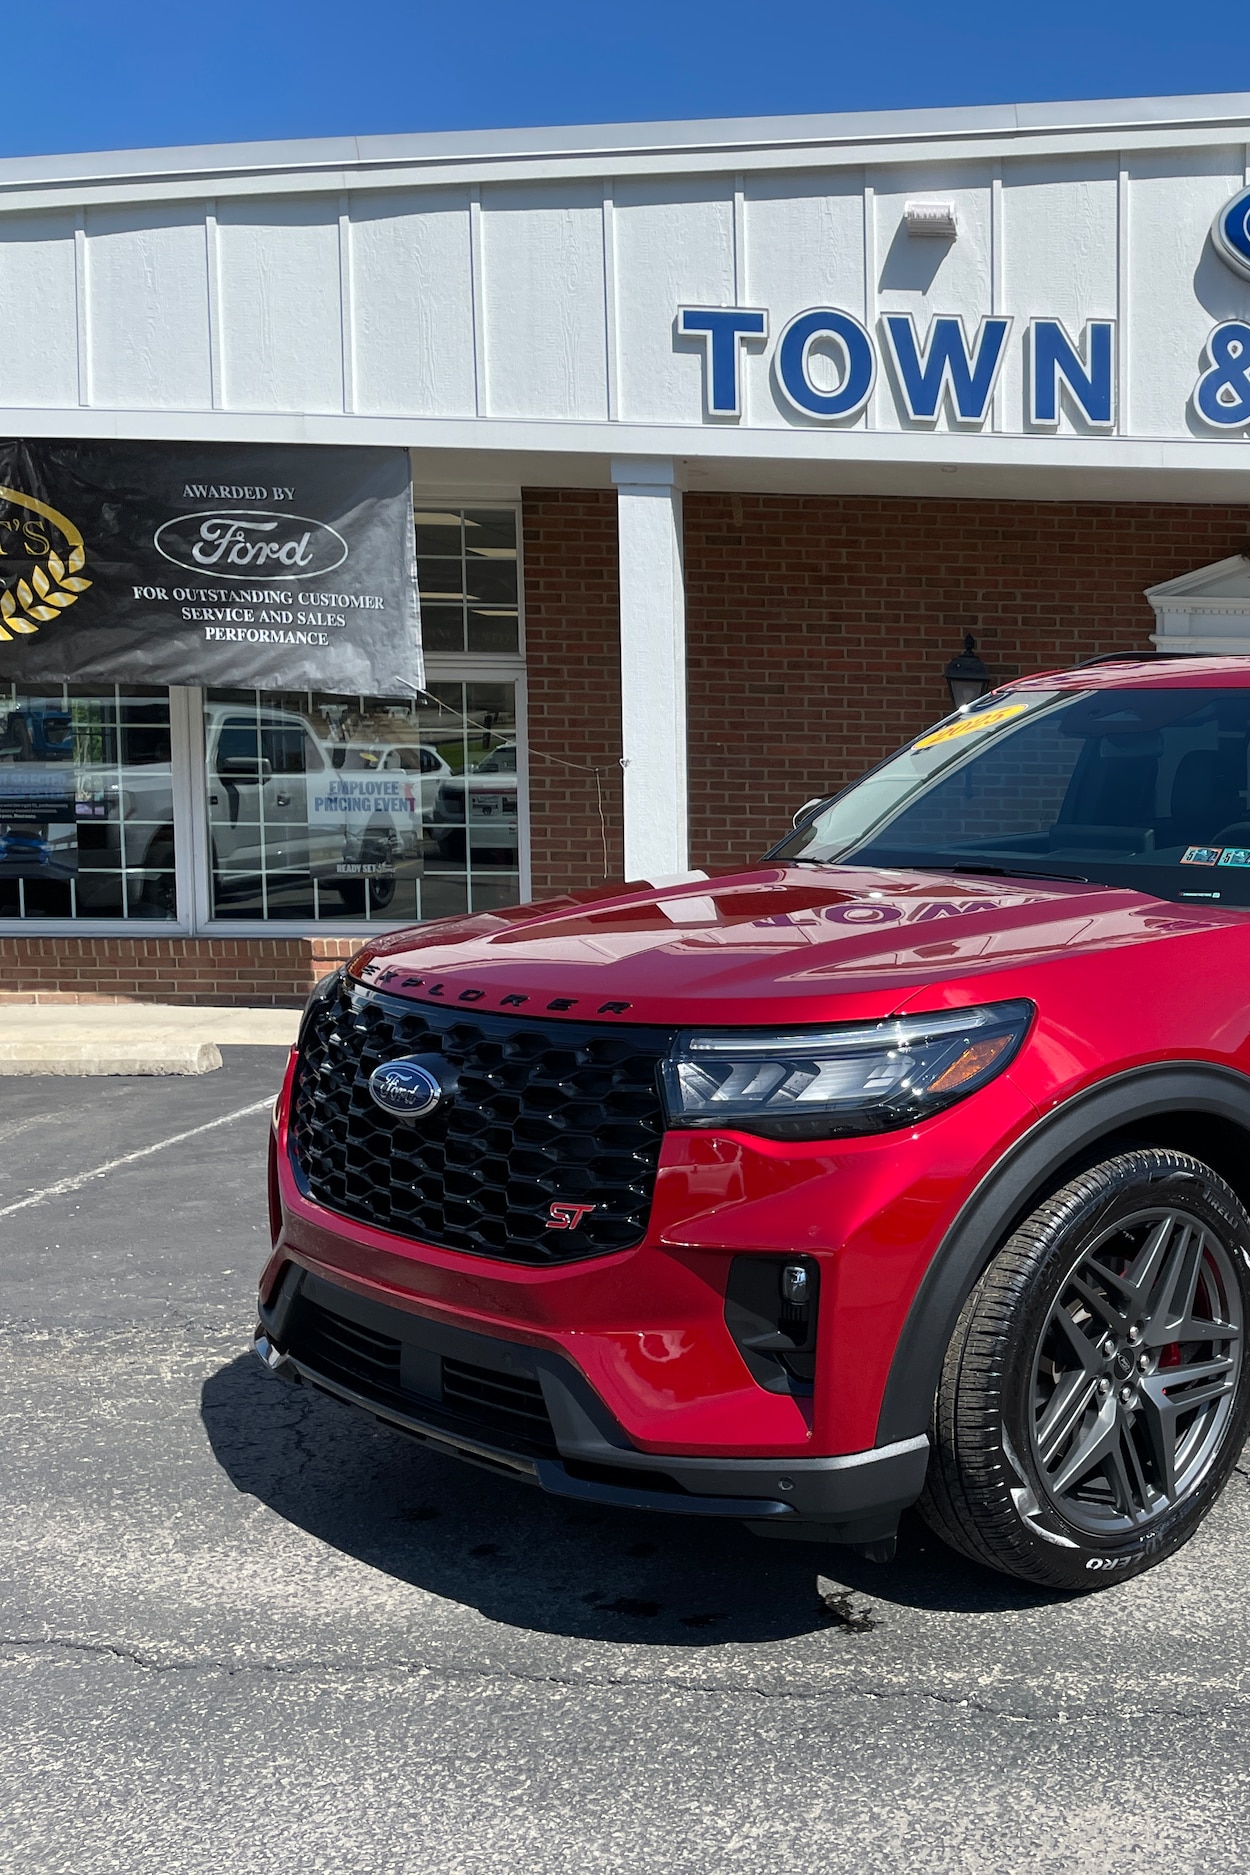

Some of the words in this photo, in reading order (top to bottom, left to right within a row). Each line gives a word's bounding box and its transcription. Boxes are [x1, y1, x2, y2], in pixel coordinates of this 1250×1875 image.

[677, 304, 1118, 428] TOWN
[183, 484, 268, 500] AWARDED
[272, 487, 296, 501] BY
[192, 518, 314, 567] Ford
[132, 586, 169, 600] FOR
[173, 588, 293, 605] OUTSTANDING
[298, 593, 385, 610] CUSTOMER
[181, 607, 254, 622] SERVICE
[259, 610, 293, 624] AND
[297, 612, 346, 627] SALES
[205, 627, 329, 646] PERFORMANCE
[329, 781, 399, 796] EMPLOYEE
[314, 797, 371, 812] PRICING
[374, 797, 416, 812] EVENT
[336, 864, 361, 873] READY
[362, 964, 634, 1015] EXPLORER
[379, 1071, 420, 1105] Ford
[545, 1201, 597, 1230] ST
